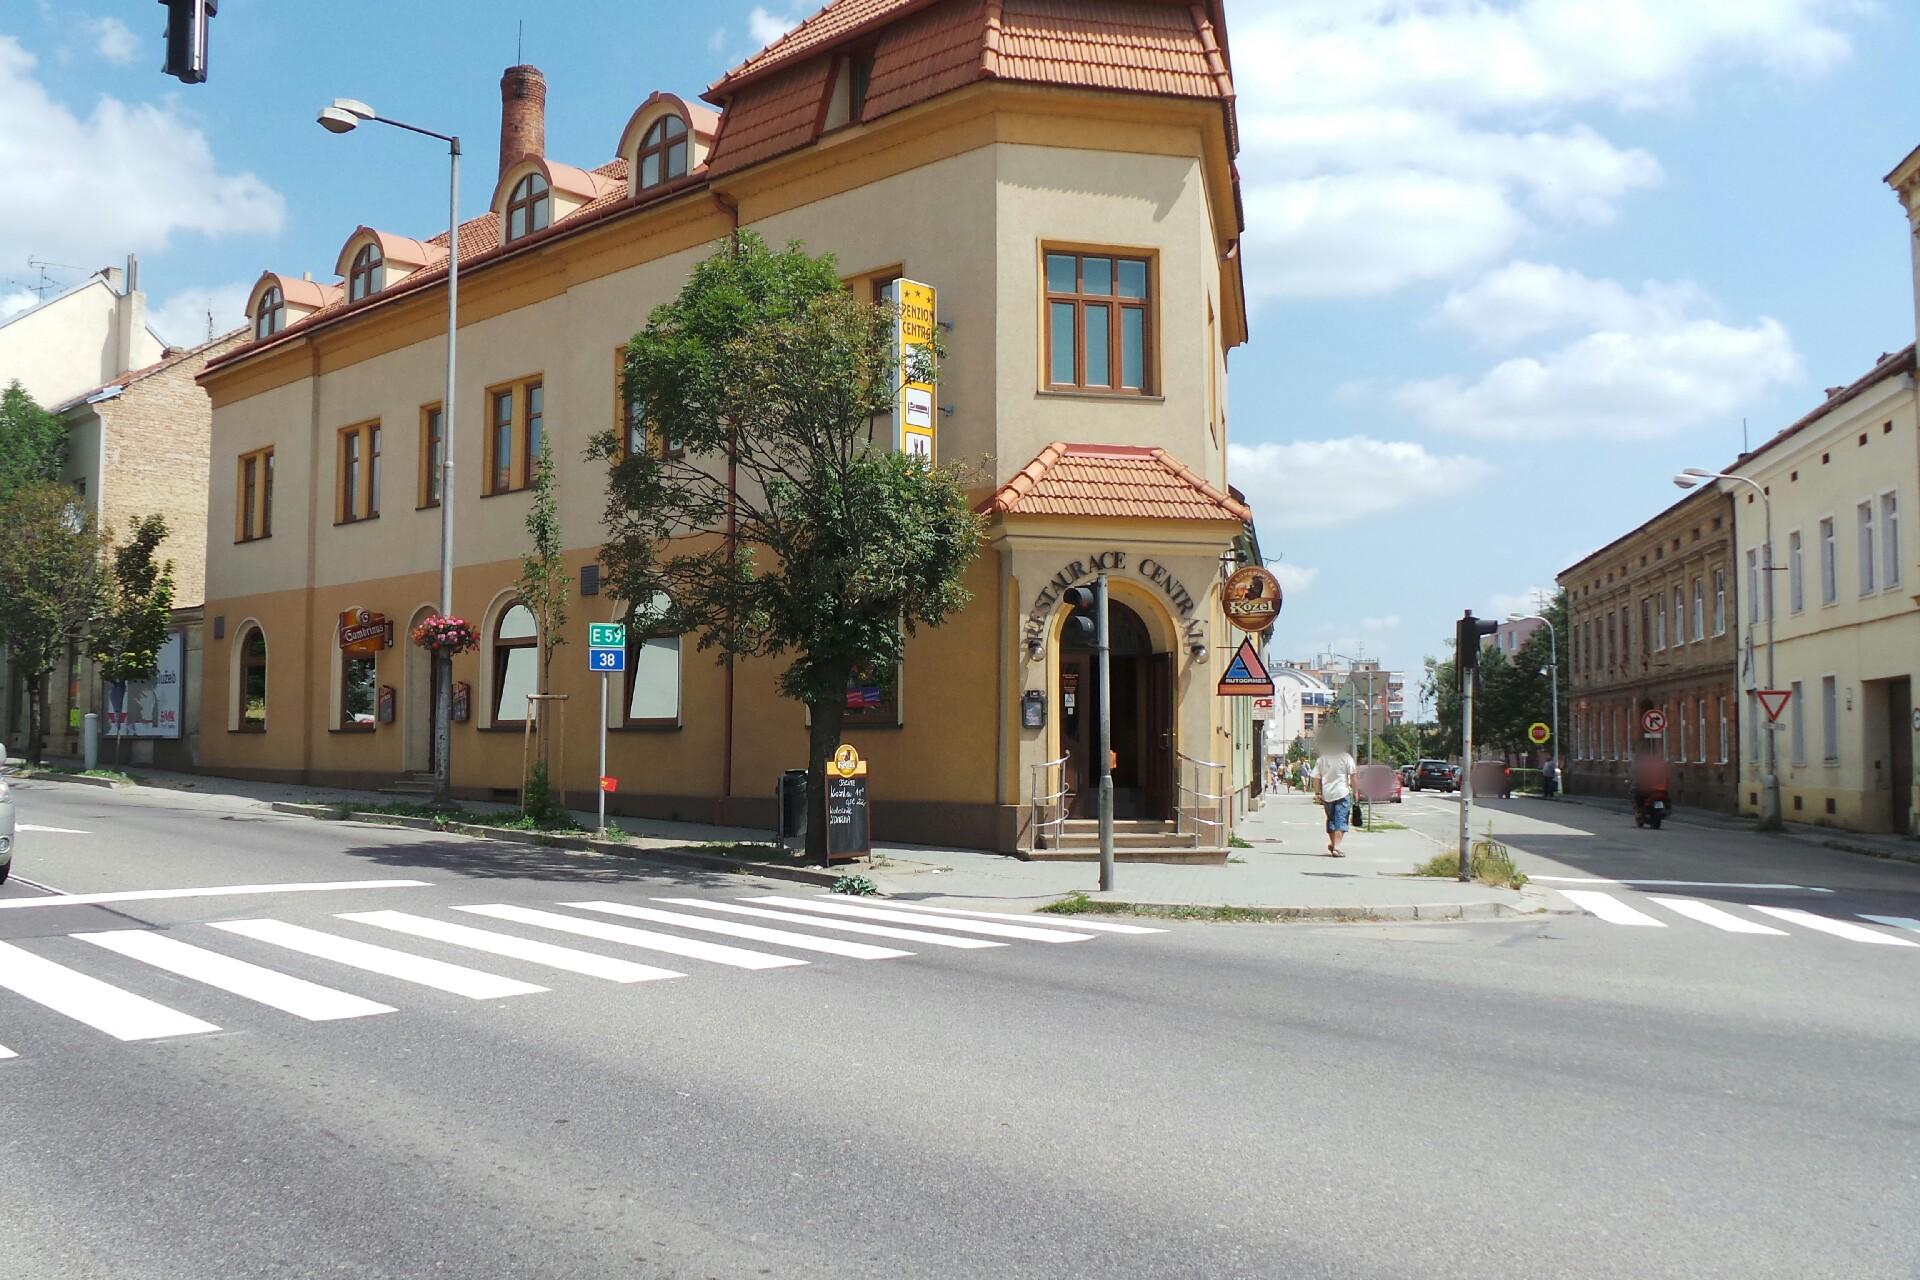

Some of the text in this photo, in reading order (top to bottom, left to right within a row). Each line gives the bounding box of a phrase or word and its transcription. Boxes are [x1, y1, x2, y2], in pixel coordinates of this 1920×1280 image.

[1026, 551, 1126, 640] RESTAURACE
[1230, 600, 1275, 615] Kozel
[345, 624, 384, 642] Gambrinus
[593, 629, 622, 643] E 59
[600, 653, 615, 667] 38
